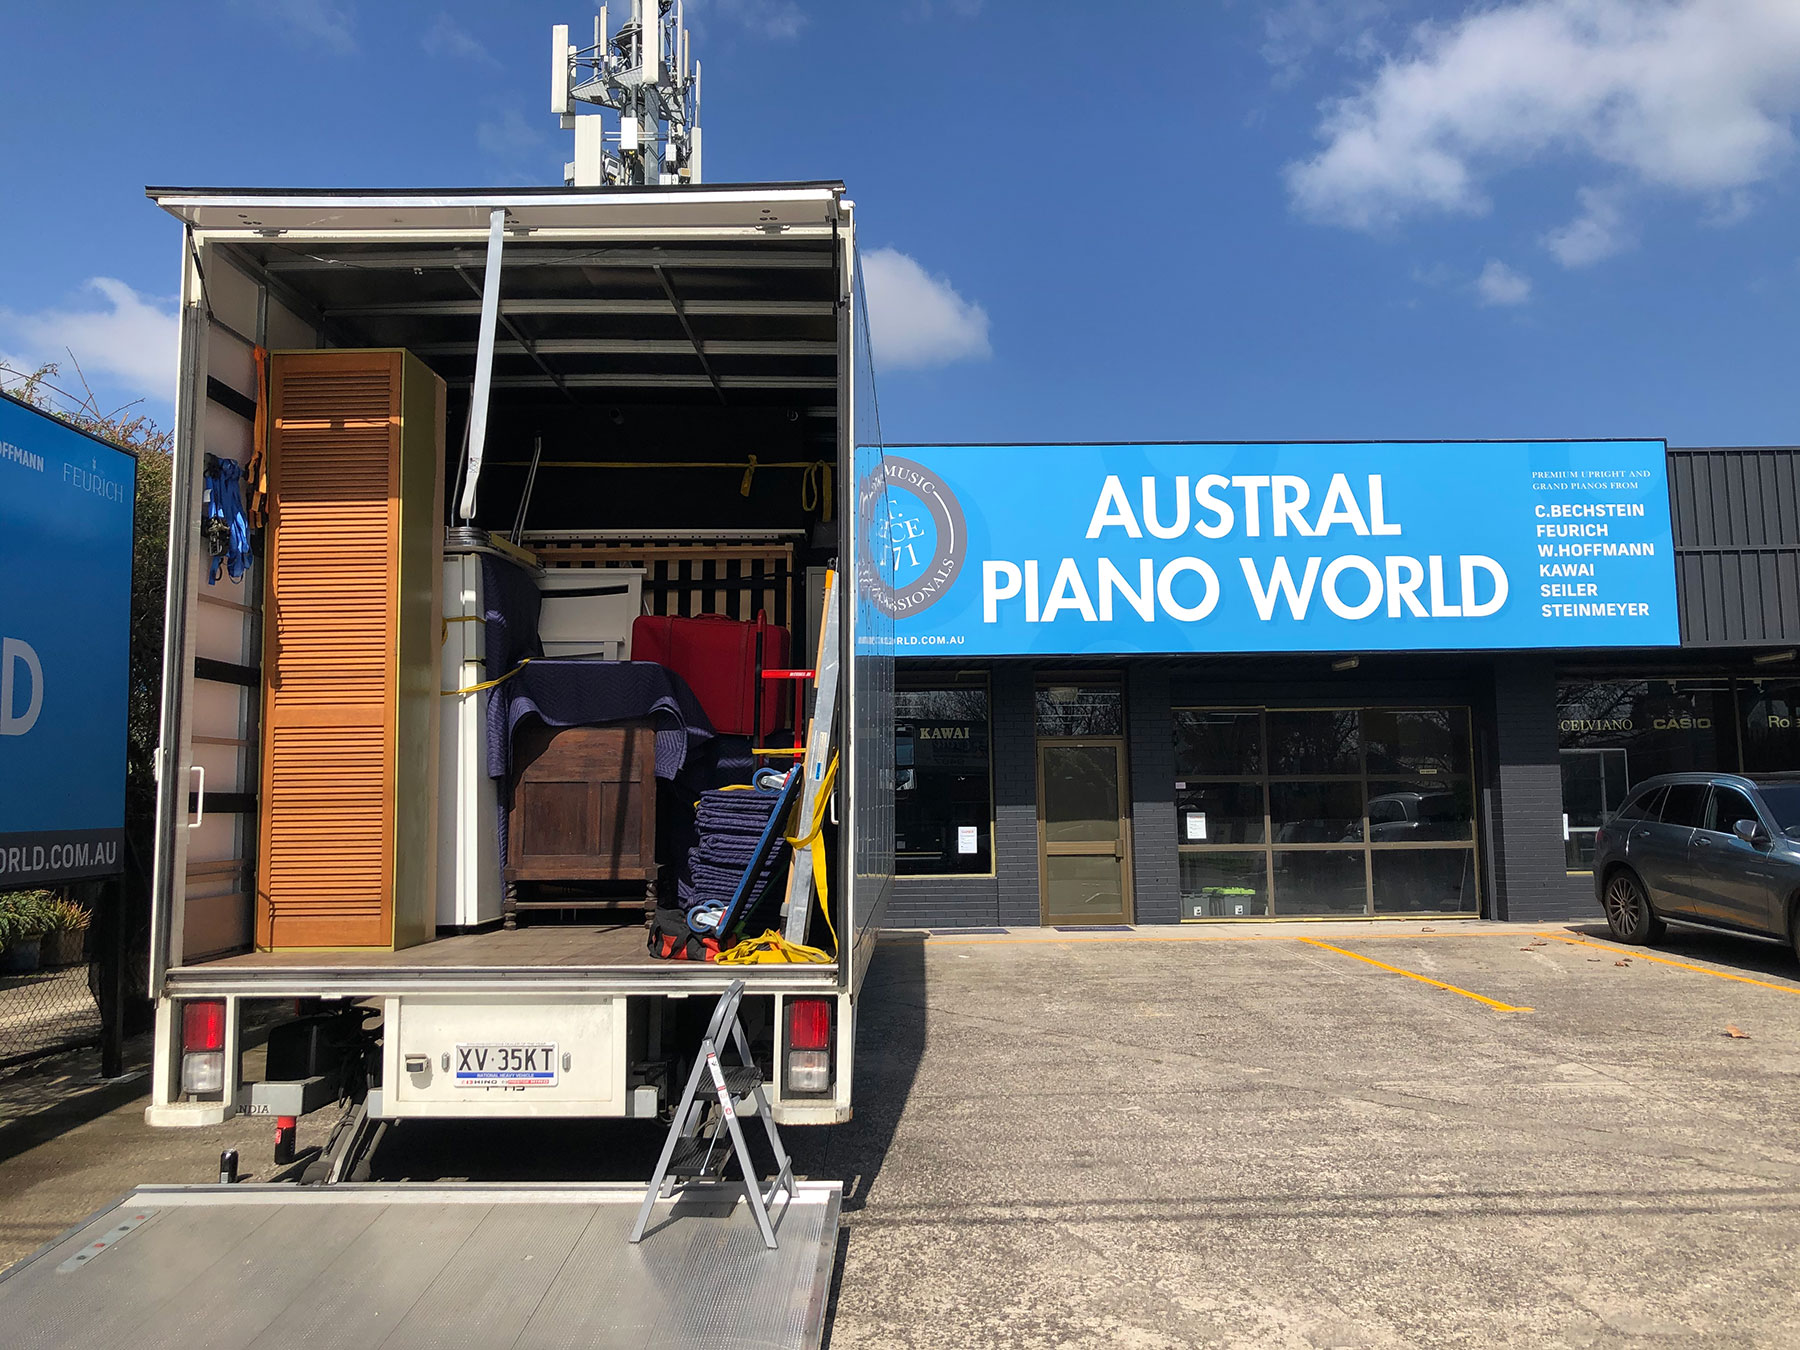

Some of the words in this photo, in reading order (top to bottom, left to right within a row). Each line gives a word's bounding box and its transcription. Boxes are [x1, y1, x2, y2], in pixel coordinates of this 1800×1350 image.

[884, 463, 935, 494] MUSIC
[1532, 471, 1578, 479] PREMIUM
[1581, 470, 1626, 478] UPRIGHT
[1629, 470, 1651, 478] AND
[63, 462, 124, 504] FEURICH
[1532, 482, 1568, 490] GRAND
[1571, 482, 1608, 490] PIANOS
[1610, 481, 1639, 489] FROM
[1085, 473, 1402, 539] AUSTRAL
[1535, 503, 1645, 518] C.BECHSTEIN
[1536, 523, 1609, 537] FEURICH
[1538, 543, 1655, 557] W.HOFFMANN
[1539, 563, 1595, 577] KAWAI
[982, 556, 1220, 624] PIANO
[1239, 554, 1509, 621] WORLD
[1540, 583, 1598, 597] SEILER
[1542, 602, 1650, 617] STEINMEYER
[895, 636, 965, 645] RLD.COM.AU
[1560, 718, 1633, 731] CELVIANO
[1653, 717, 1712, 730] CASIO
[919, 727, 970, 740] KAWAI
[236, 1104, 270, 1114] NDIA
